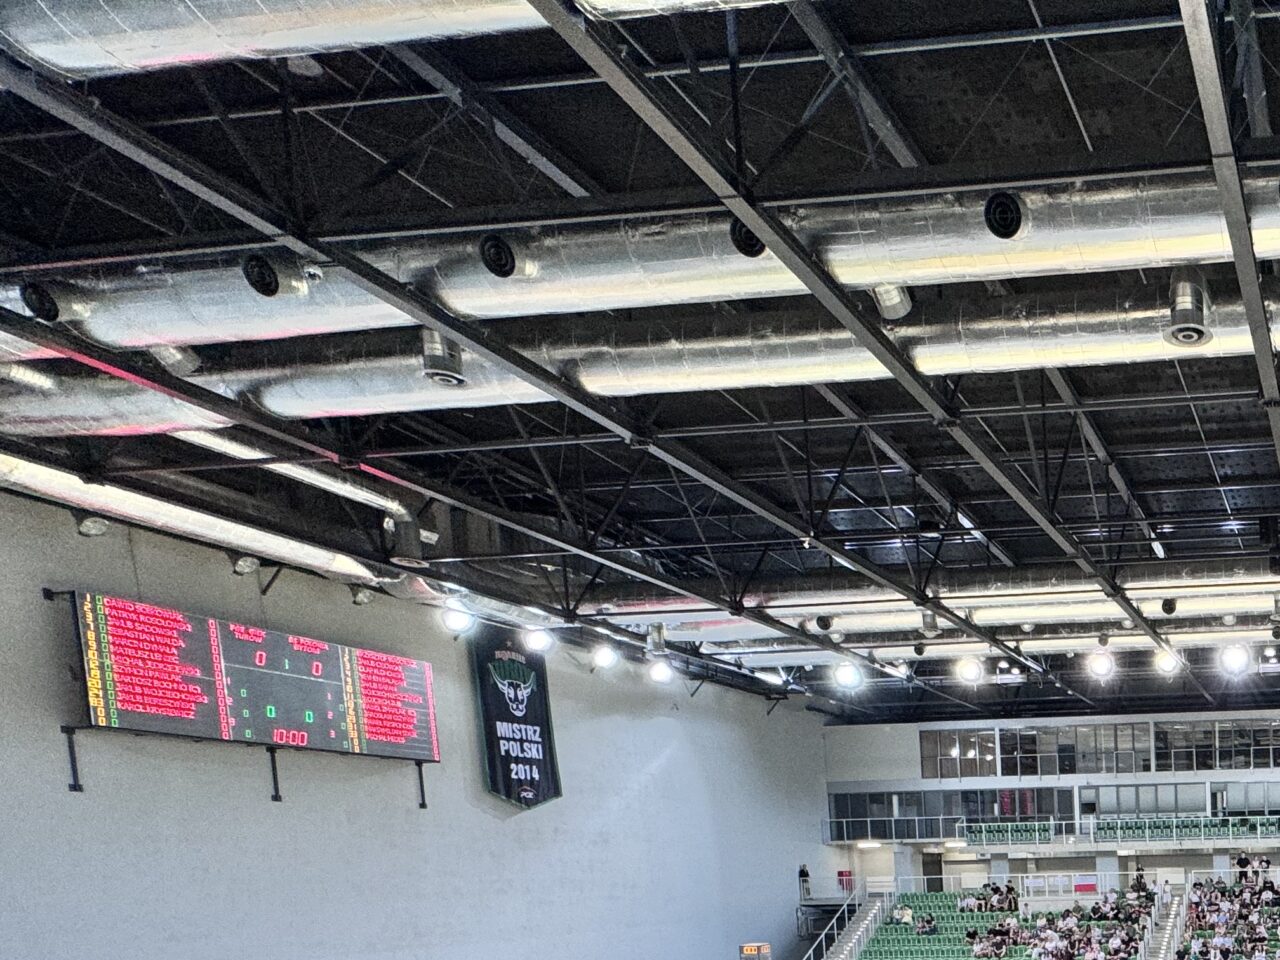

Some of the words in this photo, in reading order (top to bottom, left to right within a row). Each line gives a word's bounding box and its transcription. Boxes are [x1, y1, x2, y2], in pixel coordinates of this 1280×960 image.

[256, 651, 266, 666] 0
[312, 662, 322, 676] 0
[266, 705, 276, 718] 0
[306, 711, 314, 723] 0
[274, 729, 308, 746] 10:00
[496, 721, 542, 742] MISTRZ
[500, 740, 543, 760] POLSKI
[510, 764, 540, 781] 2014
